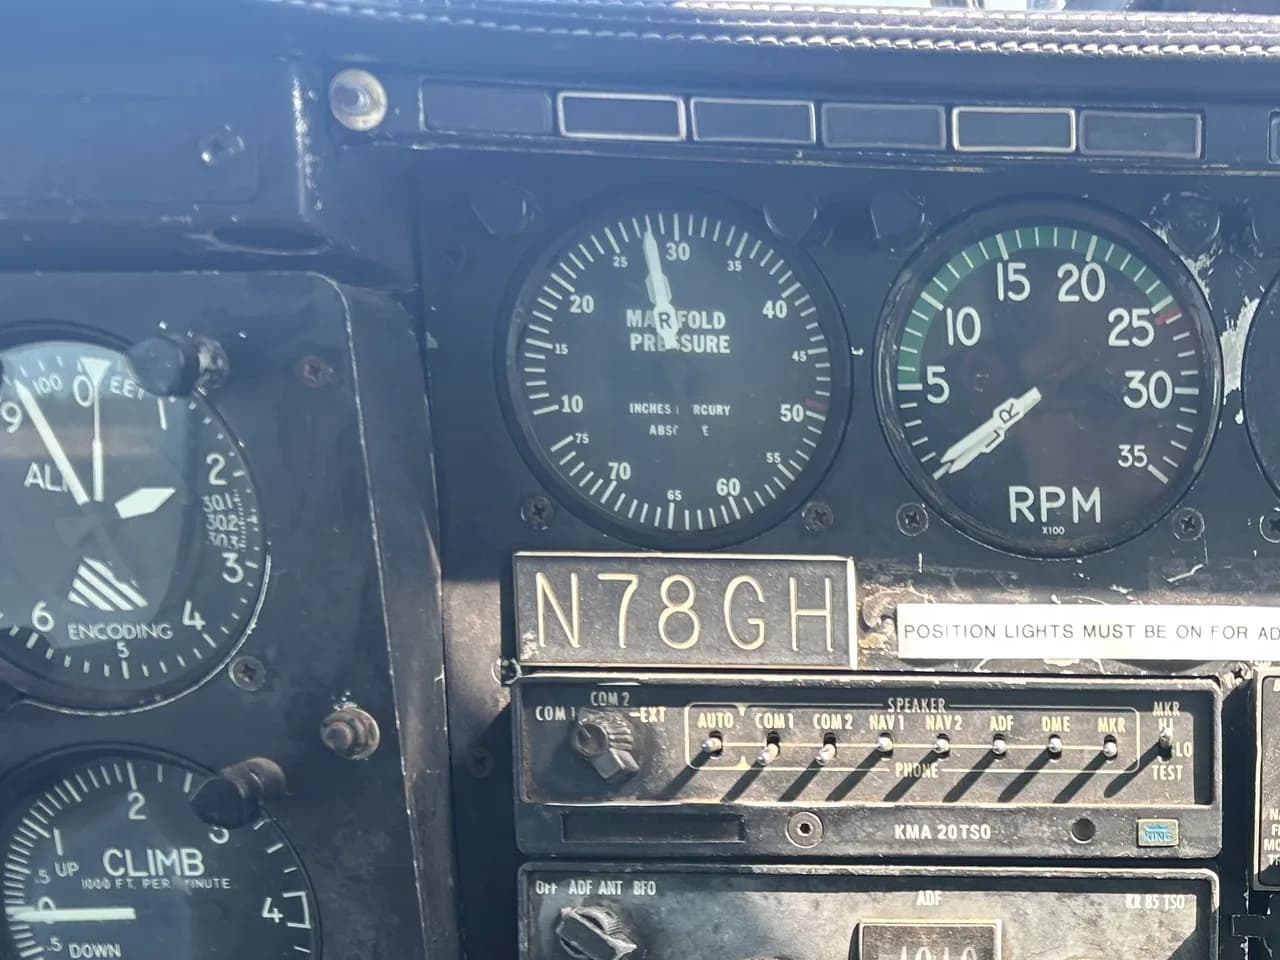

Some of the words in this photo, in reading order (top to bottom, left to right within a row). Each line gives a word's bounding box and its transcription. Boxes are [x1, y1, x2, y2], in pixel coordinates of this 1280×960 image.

[666, 243, 690, 261] 30
[997, 263, 1030, 301] 15
[1057, 263, 1106, 302] 20
[570, 295, 594, 314] 20
[762, 300, 788, 318] 40
[946, 307, 981, 346] 10
[1108, 308, 1154, 346] 25
[926, 367, 949, 403] 5
[1123, 370, 1173, 408] 30
[561, 395, 584, 413] 10
[629, 403, 672, 415] INCHES
[780, 404, 804, 422] 50
[1118, 445, 1147, 468] 35
[608, 462, 632, 480] 70
[716, 478, 740, 496] 60
[1009, 486, 1101, 523] RPM
[536, 572, 834, 652] N78GH
[68, 624, 173, 641] ENCODING
[905, 624, 996, 639] POSITION
[1005, 624, 1073, 639] LIGHTS
[1083, 624, 1133, 640] MUST
[1145, 625, 1167, 640] BE
[1176, 625, 1201, 640] ON
[1211, 626, 1248, 641] FOR
[888, 698, 946, 714] SPEAKER
[698, 713, 733, 728] AUTO
[990, 716, 1014, 732] ADF
[1041, 717, 1070, 732] DME
[1098, 718, 1126, 733] MKR
[1152, 765, 1183, 780] TEST
[895, 825, 931, 839] KMA
[55, 862, 79, 878] UP
[103, 849, 205, 877] CLIMB
[142, 878, 170, 890] PER
[568, 881, 593, 895] ADF
[598, 881, 623, 895] ANT
[262, 897, 284, 923] 4
[69, 944, 121, 959] DOWN
